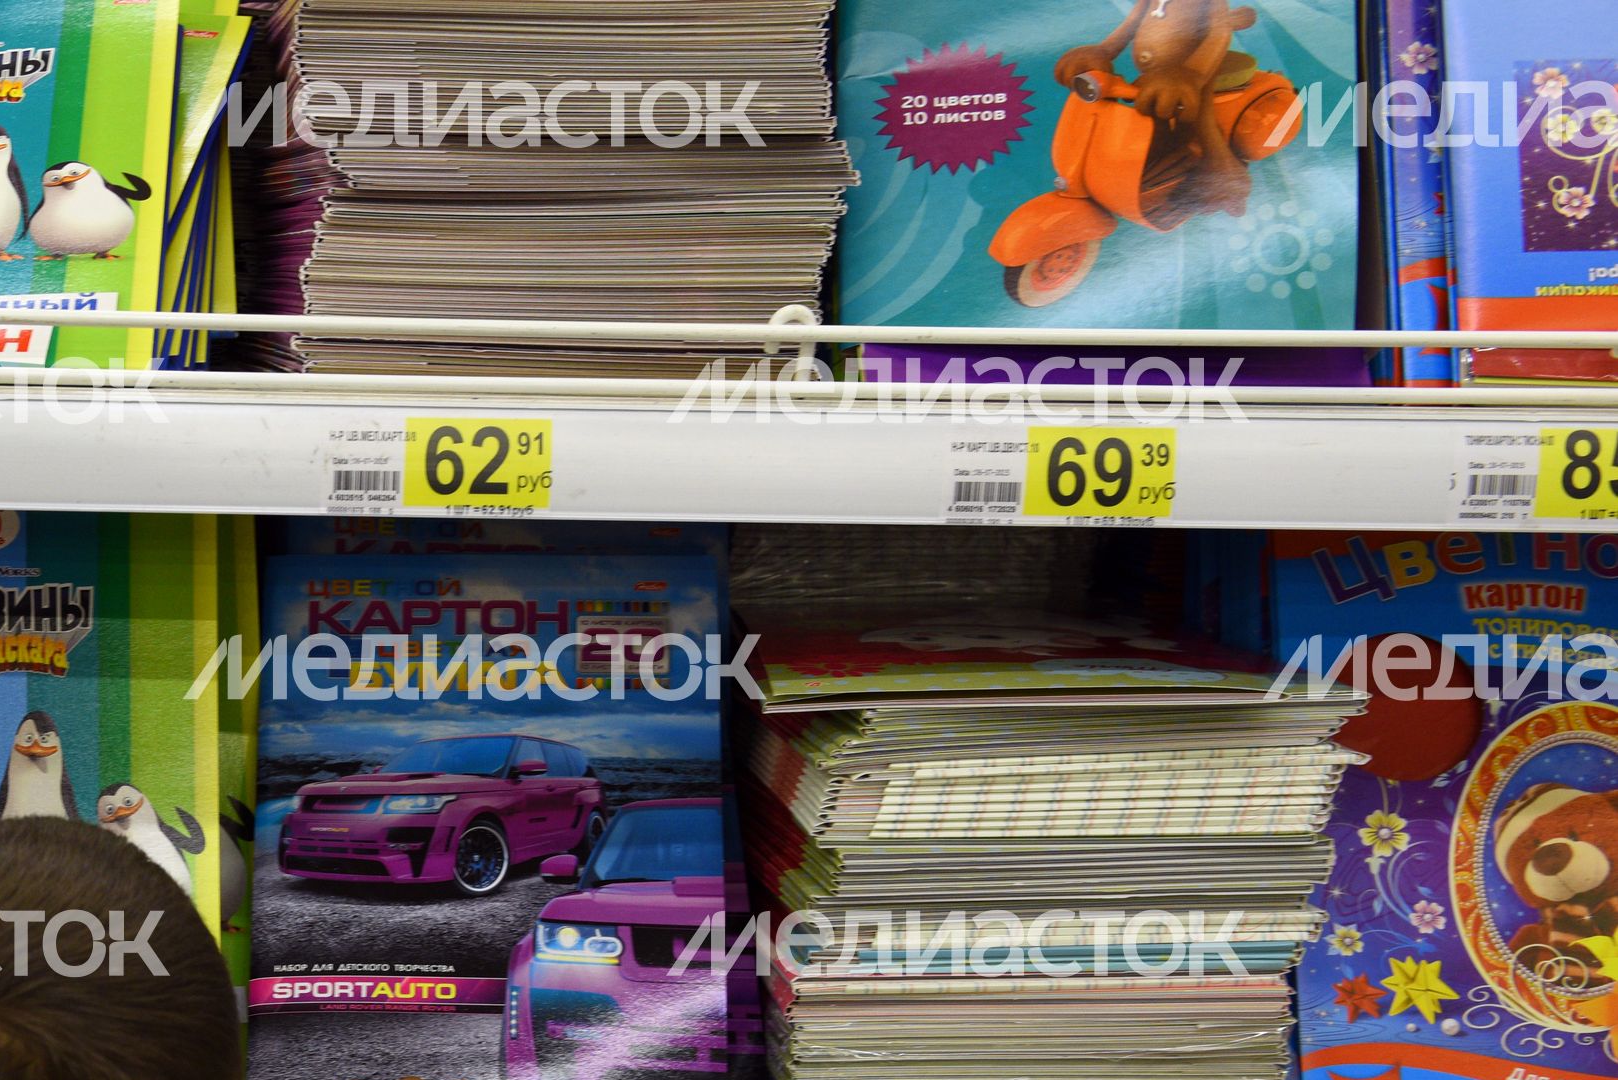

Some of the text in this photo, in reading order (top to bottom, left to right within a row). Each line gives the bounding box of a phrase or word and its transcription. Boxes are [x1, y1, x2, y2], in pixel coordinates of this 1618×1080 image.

[900, 92, 1008, 109] 20 цветов
[902, 110, 1007, 125] 10 листов
[517, 433, 544, 455] 91
[1142, 444, 1169, 466] 39
[426, 426, 510, 496] 62
[1048, 437, 1132, 507] 69
[1562, 430, 1618, 500] 8
[517, 471, 553, 492] руб
[1139, 482, 1175, 504] руб
[307, 576, 462, 598] ЦВЕТОЙ
[1463, 583, 1585, 611] картон
[308, 599, 569, 635] КАРТОН
[273, 963, 456, 973] НАБОР ДЛЯ ДЕТСКОГО ТВОРЧЕСТВА
[272, 981, 457, 1000] SPORTAUTO
